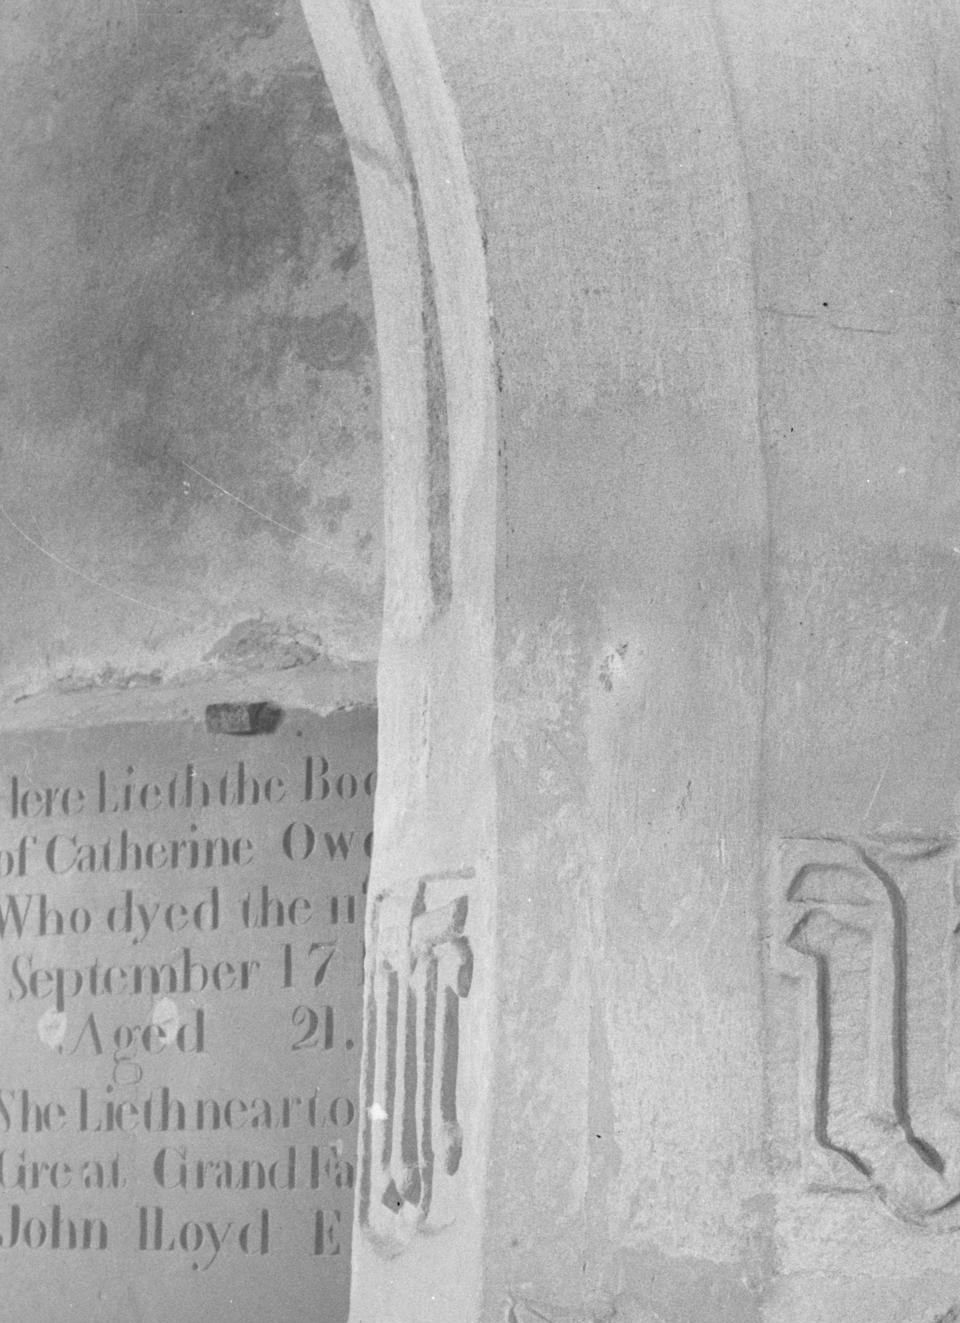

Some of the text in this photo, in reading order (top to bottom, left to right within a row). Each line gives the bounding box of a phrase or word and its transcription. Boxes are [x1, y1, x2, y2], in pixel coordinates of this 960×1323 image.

[219, 760, 286, 806] the
[46, 822, 253, 874] Catherine
[0, 893, 91, 939] Who
[107, 882, 219, 945] dyed
[241, 885, 312, 928] the
[8, 947, 260, 1012] September
[291, 1005, 354, 1050] 21.
[196, 1097, 302, 1130] near
[308, 1086, 355, 1129] to
[0, 1150, 126, 1192] Great
[153, 1146, 296, 1192] Grand
[0, 1204, 108, 1250] John
